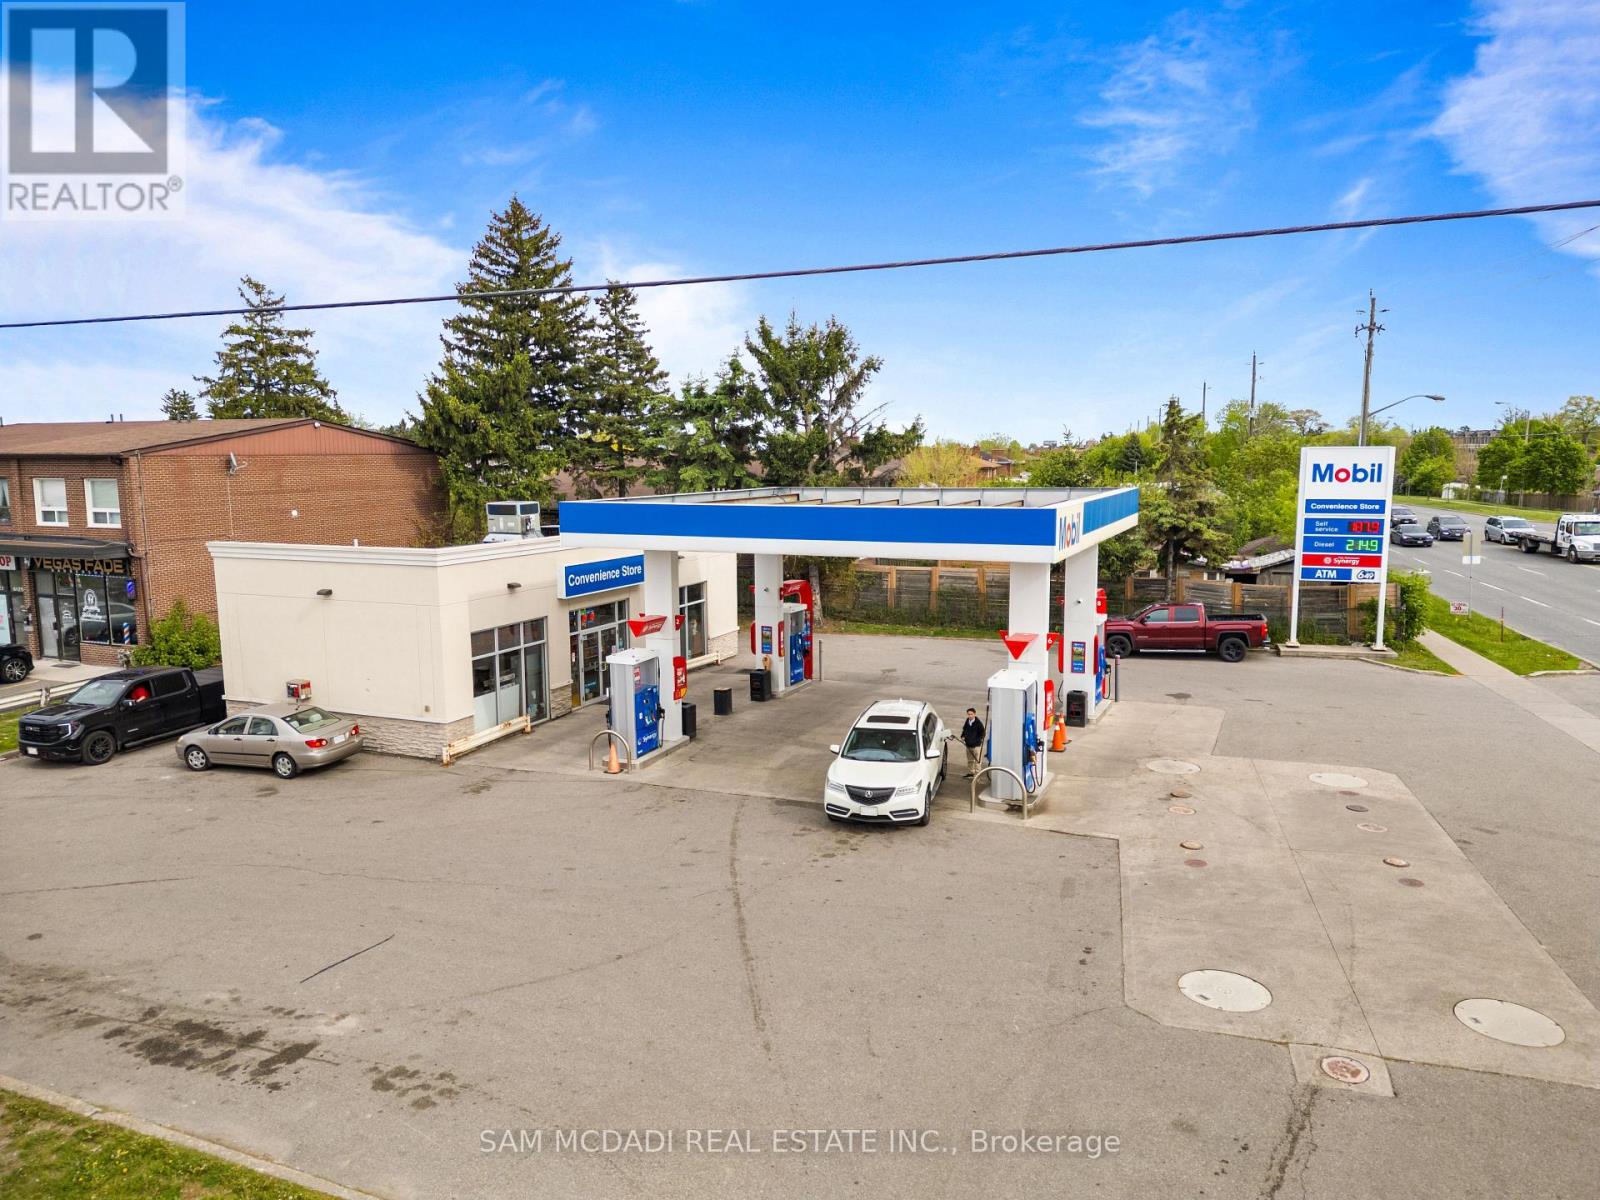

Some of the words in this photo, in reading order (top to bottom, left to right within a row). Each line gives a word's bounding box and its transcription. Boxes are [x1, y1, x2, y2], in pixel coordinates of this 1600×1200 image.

[1312, 463, 1383, 483] Mobil
[1310, 503, 1358, 511] Convenience
[1359, 503, 1380, 511] Store
[1058, 511, 1081, 552] Mobil
[33, 556, 81, 571] VEGAS
[84, 558, 125, 574] FADE
[1333, 557, 1360, 566] Synergy
[568, 568, 620, 587] Convenience
[621, 565, 642, 577] Store
[1315, 569, 1337, 579] ATM
